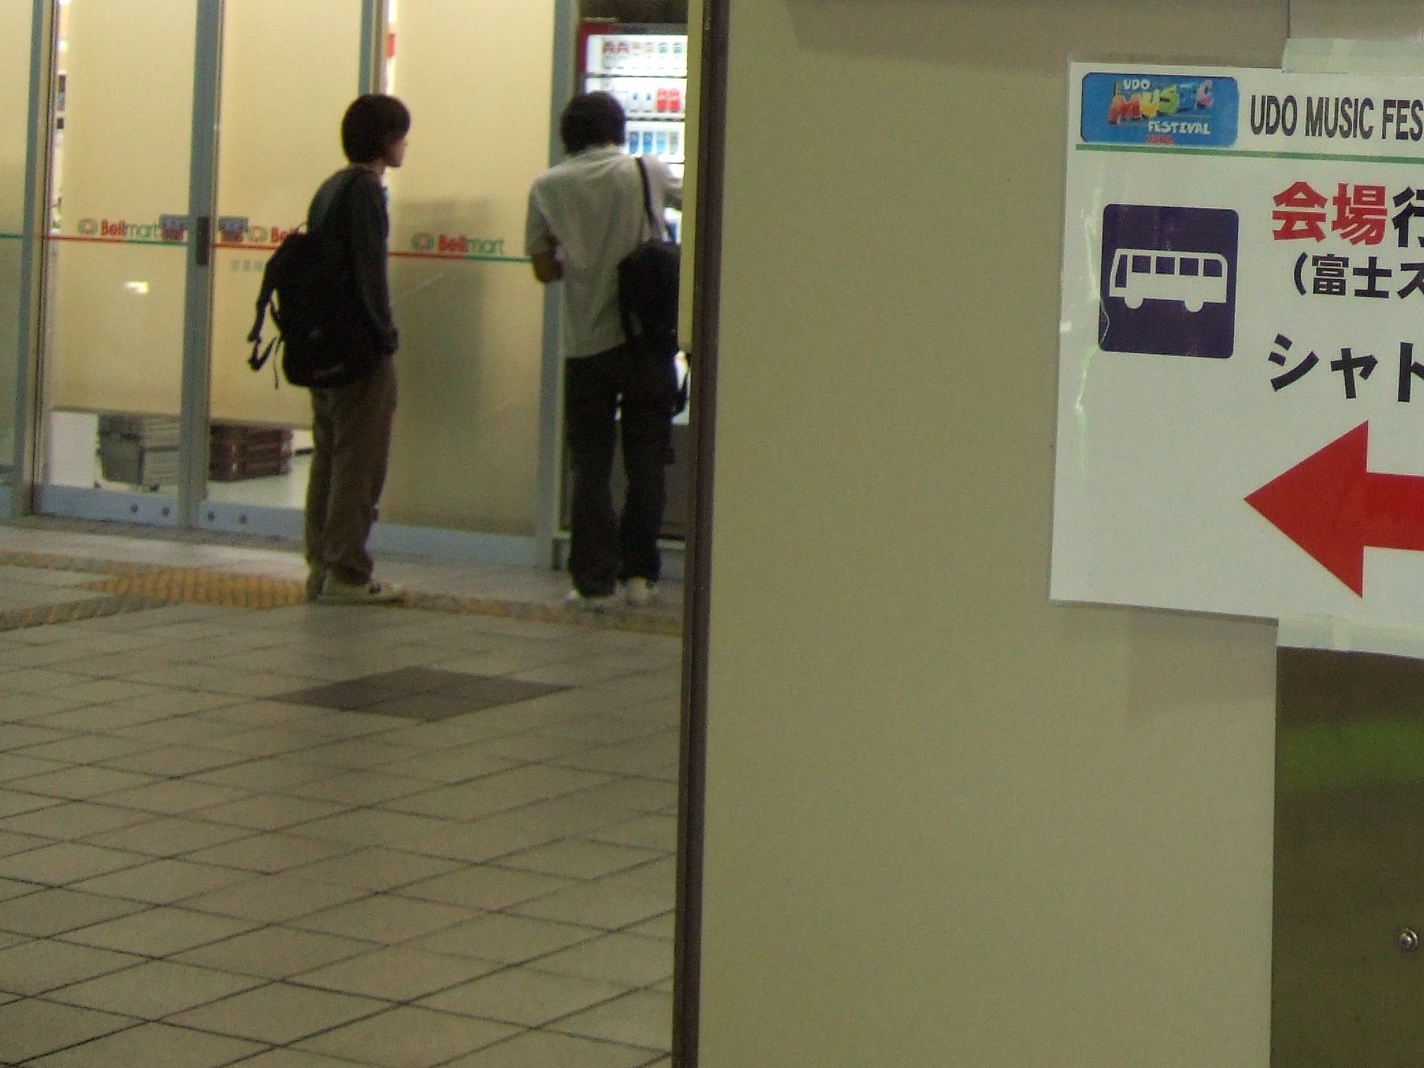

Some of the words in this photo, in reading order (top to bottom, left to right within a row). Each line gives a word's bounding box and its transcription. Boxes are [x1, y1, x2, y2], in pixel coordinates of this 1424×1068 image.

[1123, 79, 1150, 90] UDO
[1250, 94, 1297, 136] UDO
[1306, 97, 1374, 140] MUSIC
[1148, 120, 1211, 135] FESTIVAL
[101, 218, 159, 238] Bellmart
[439, 233, 505, 254] Bellmart
